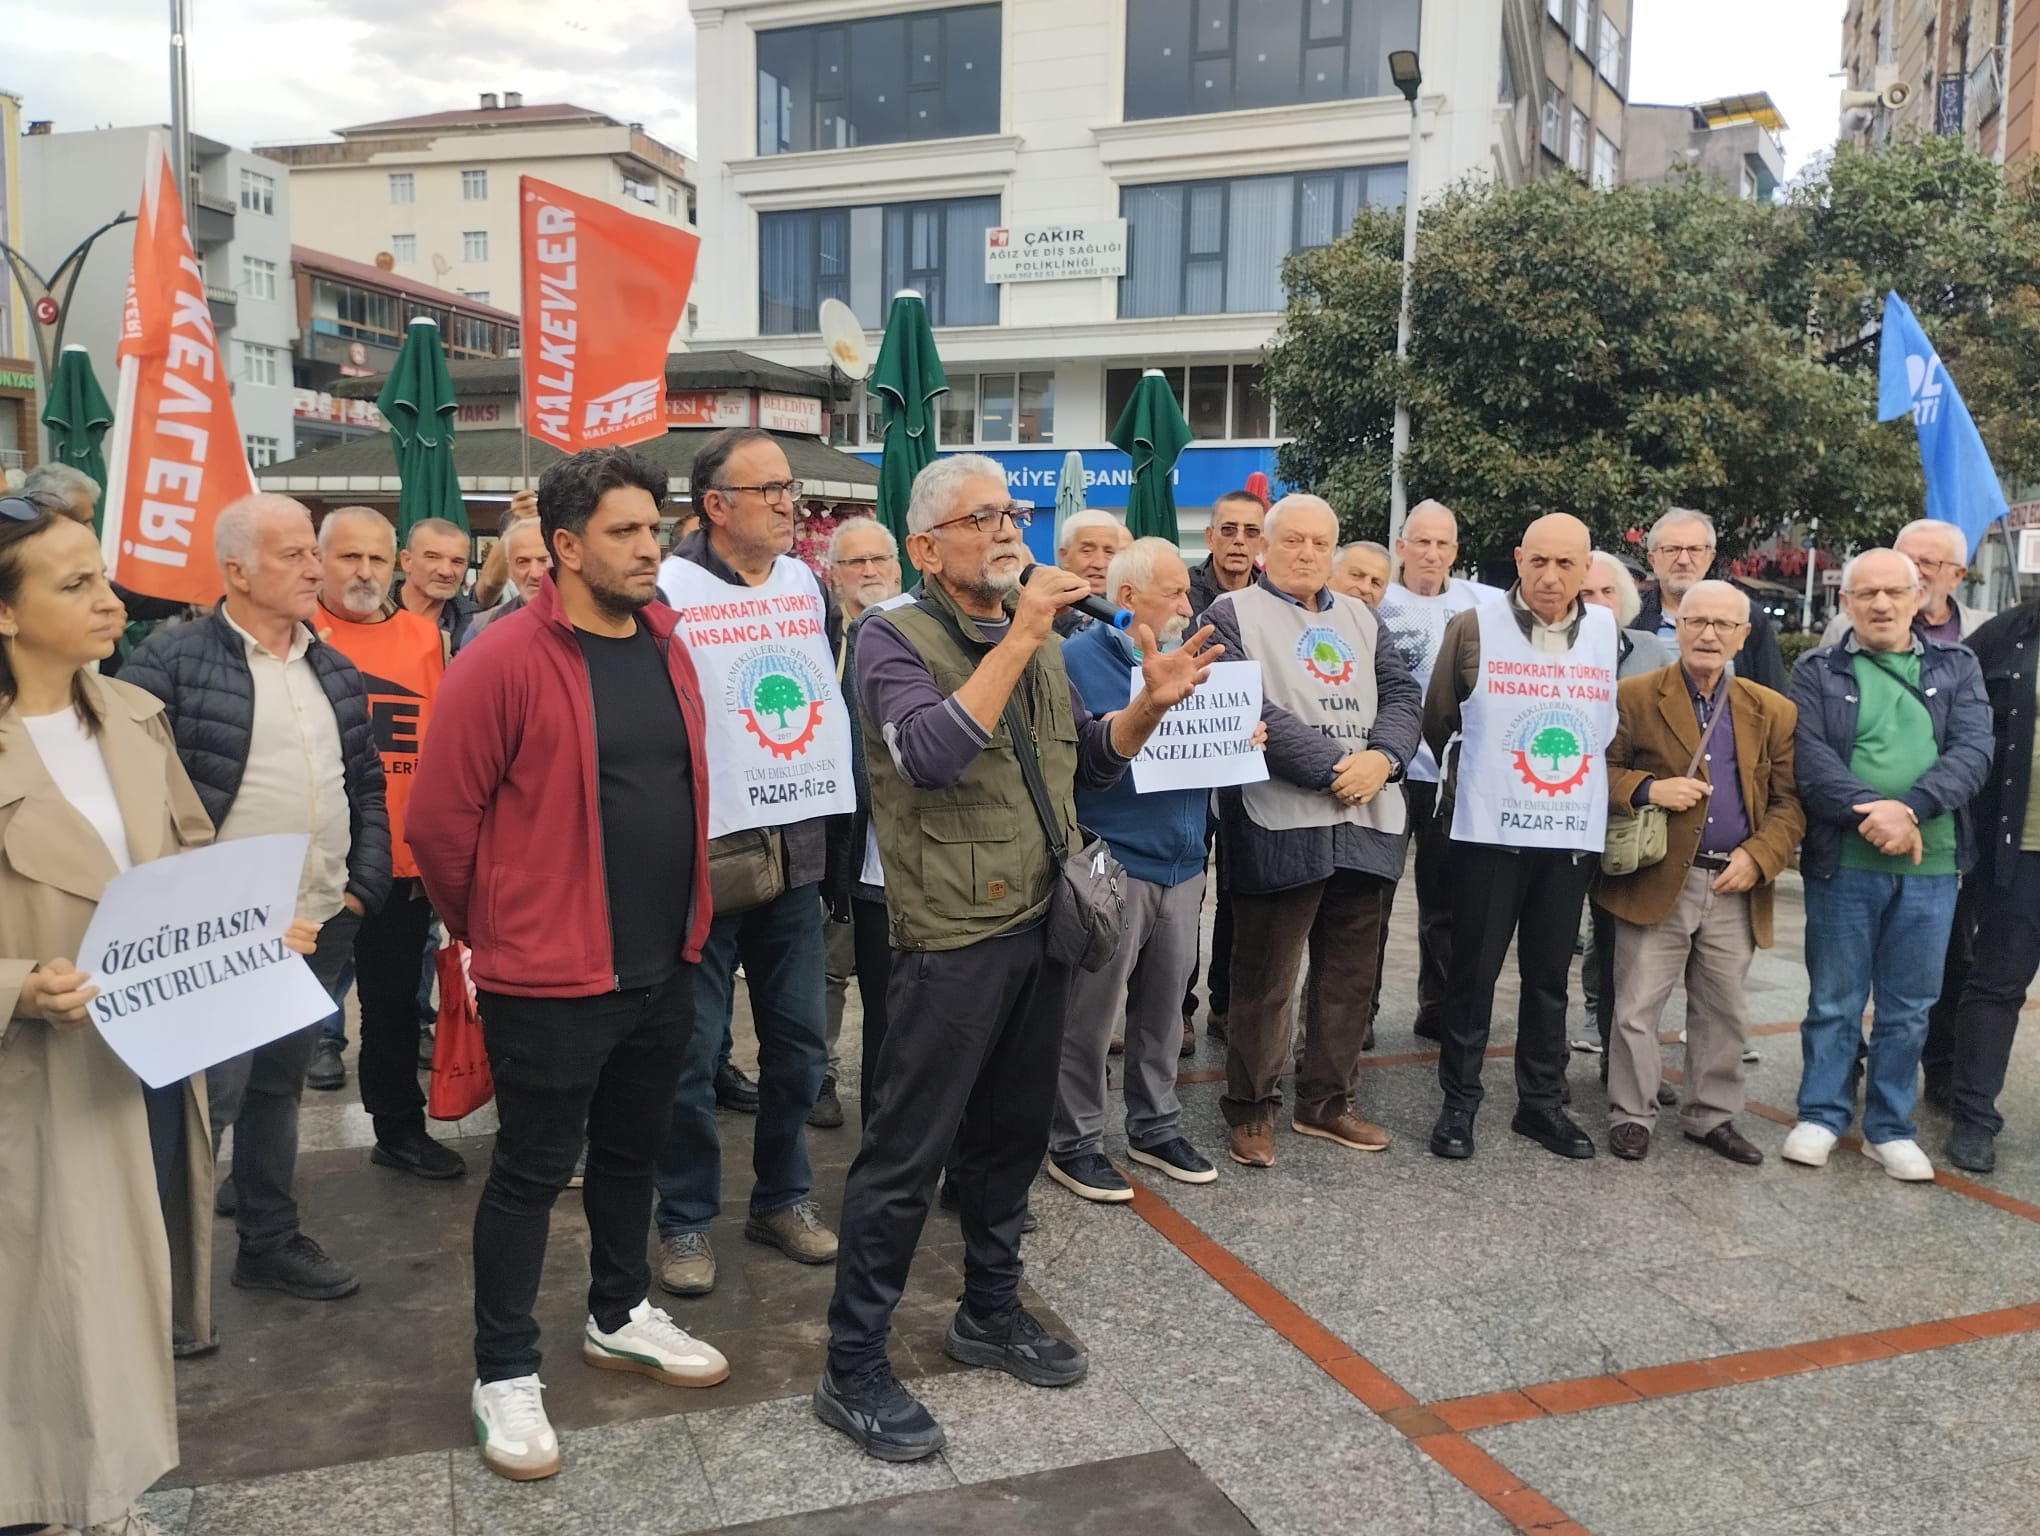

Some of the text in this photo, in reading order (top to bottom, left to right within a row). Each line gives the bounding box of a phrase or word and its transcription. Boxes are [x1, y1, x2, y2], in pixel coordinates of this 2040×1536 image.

[1024, 229, 1085, 246] ÇAKIR
[989, 241, 1121, 260] AĞIZ VE DİŞ SAĞLIĞI
[1015, 256, 1095, 272] POLİKLİNİĞİ
[665, 396, 697, 415] FESİ
[763, 397, 816, 416] BELEDİYE
[1006, 466, 1056, 487] KİYE
[680, 596, 772, 624] DEMOKRATİK
[689, 624, 772, 648] İNSANCA
[1487, 659, 1610, 683] DEMOKRATİK TÜRKİYE
[1487, 676, 1610, 703] İNSANCA YAŞAM
[1168, 691, 1251, 713] BER ALMA
[1318, 693, 1360, 712] TÜM
[1158, 715, 1243, 738] HAKKIMIZ
[744, 767, 767, 782] TÜM
[101, 904, 271, 976] ÖZGÜR BASIN
[94, 936, 292, 1024] SUSTURULAMAZ
